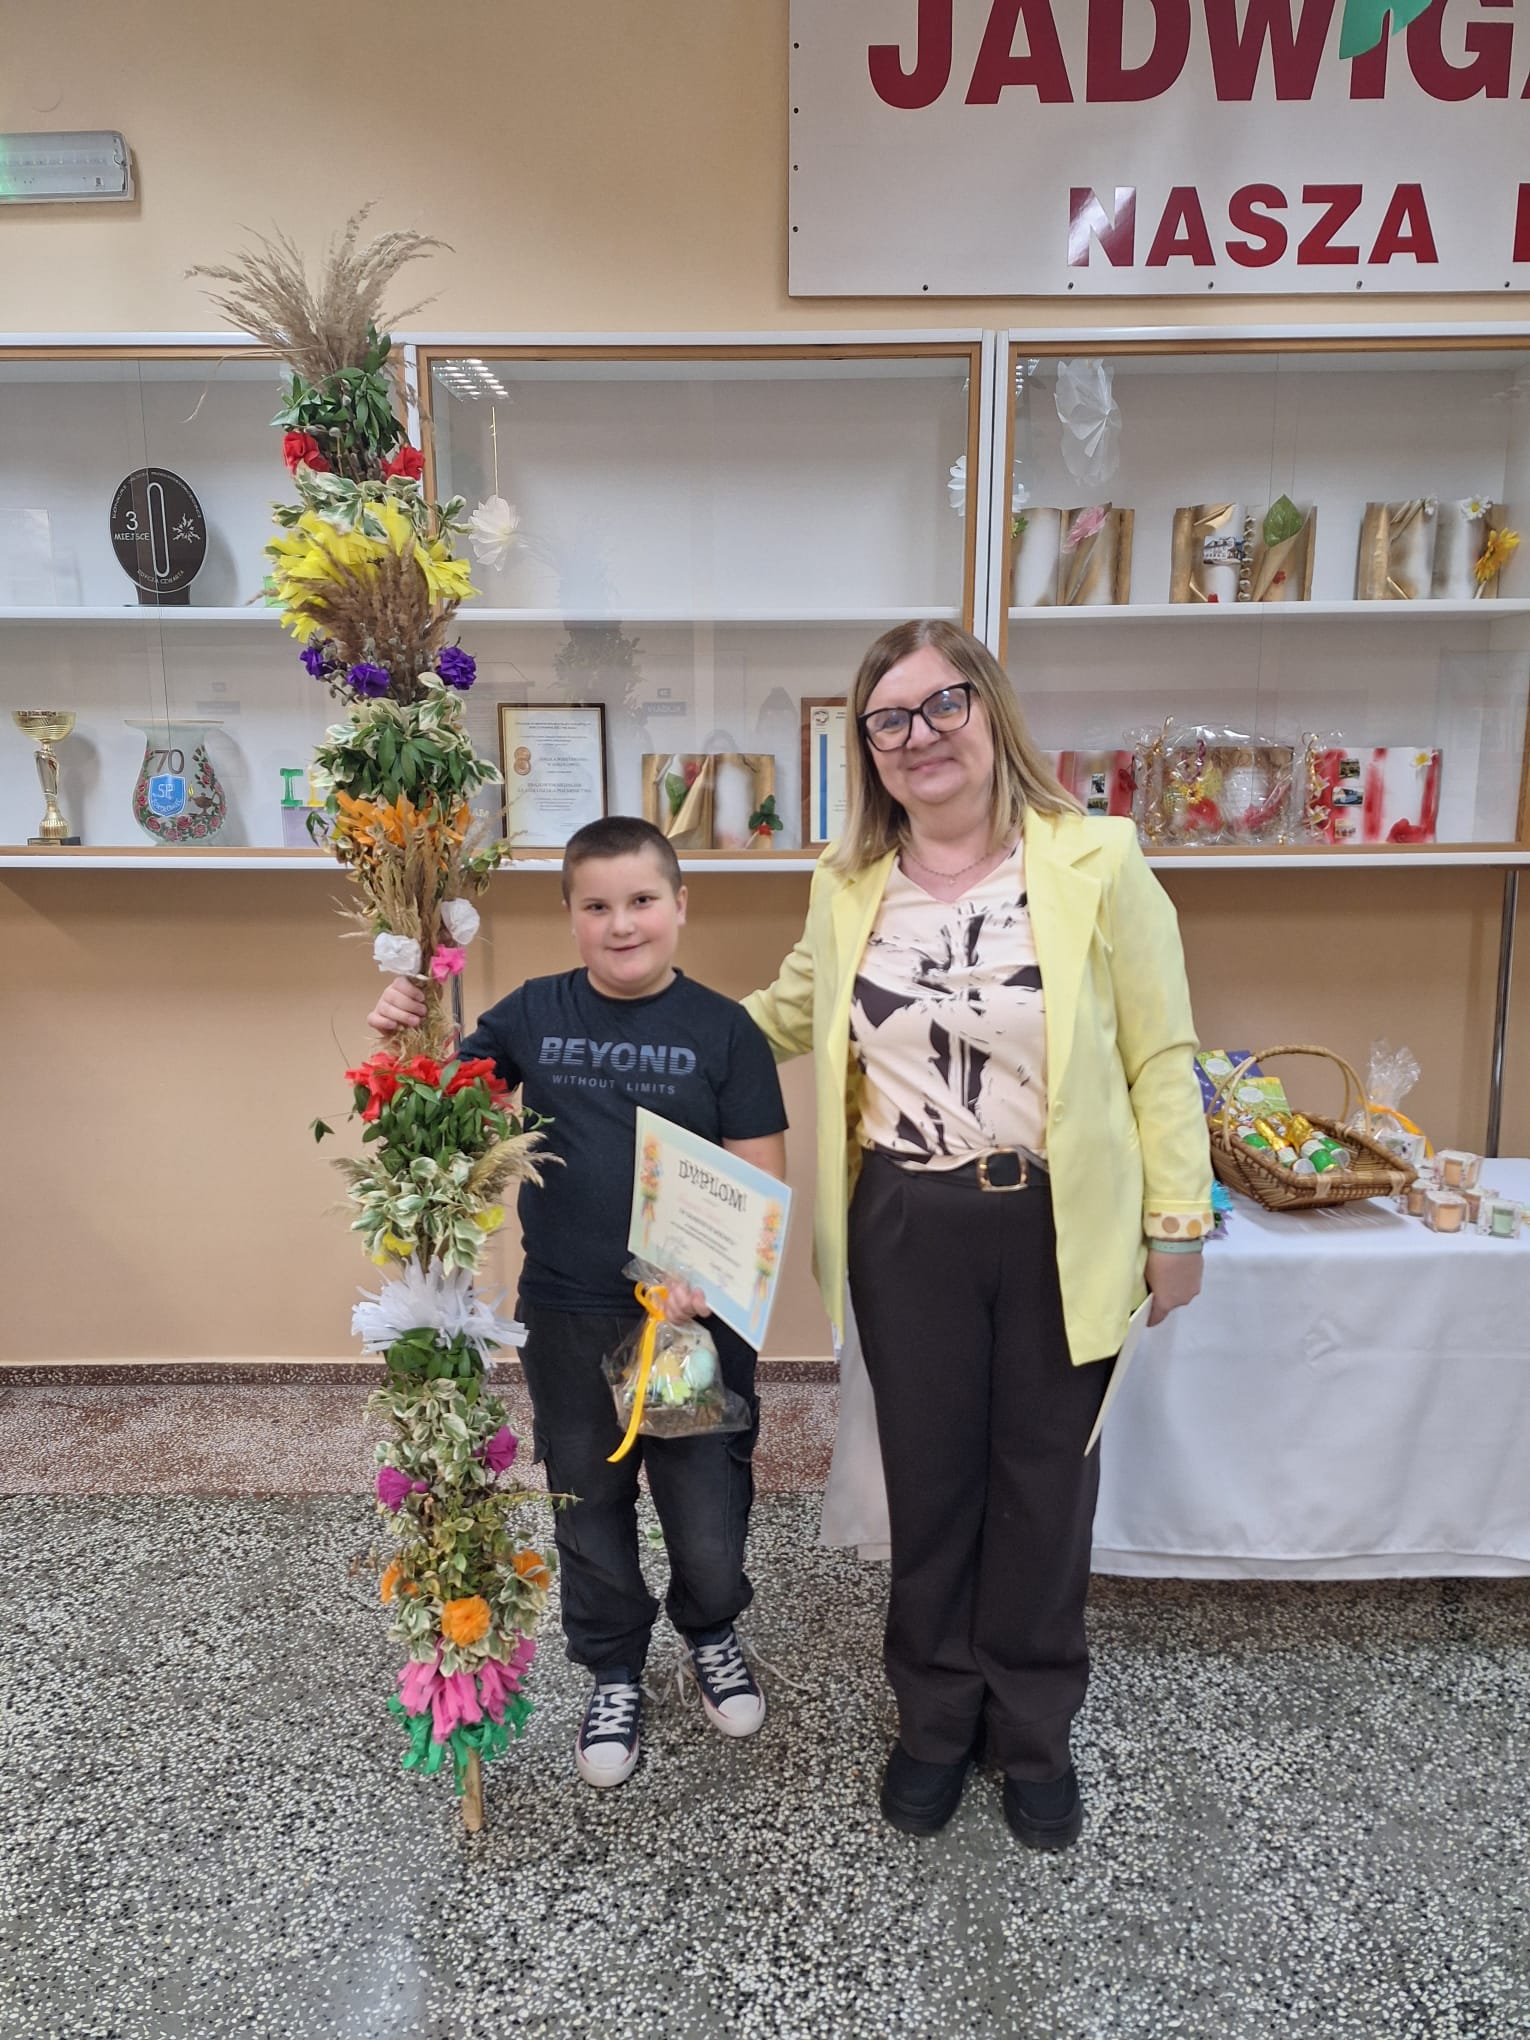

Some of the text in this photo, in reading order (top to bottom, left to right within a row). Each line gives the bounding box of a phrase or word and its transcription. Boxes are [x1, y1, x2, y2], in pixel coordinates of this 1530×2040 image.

[868, 0, 1530, 109] JADWG
[1067, 183, 1439, 268] NASZA
[125, 510, 138, 531] 3
[114, 532, 150, 541] MIEJSCE
[154, 749, 185, 775] 70
[538, 1036, 697, 1075] BEYOND
[552, 1074, 676, 1095] WITHOUT LIMITS
